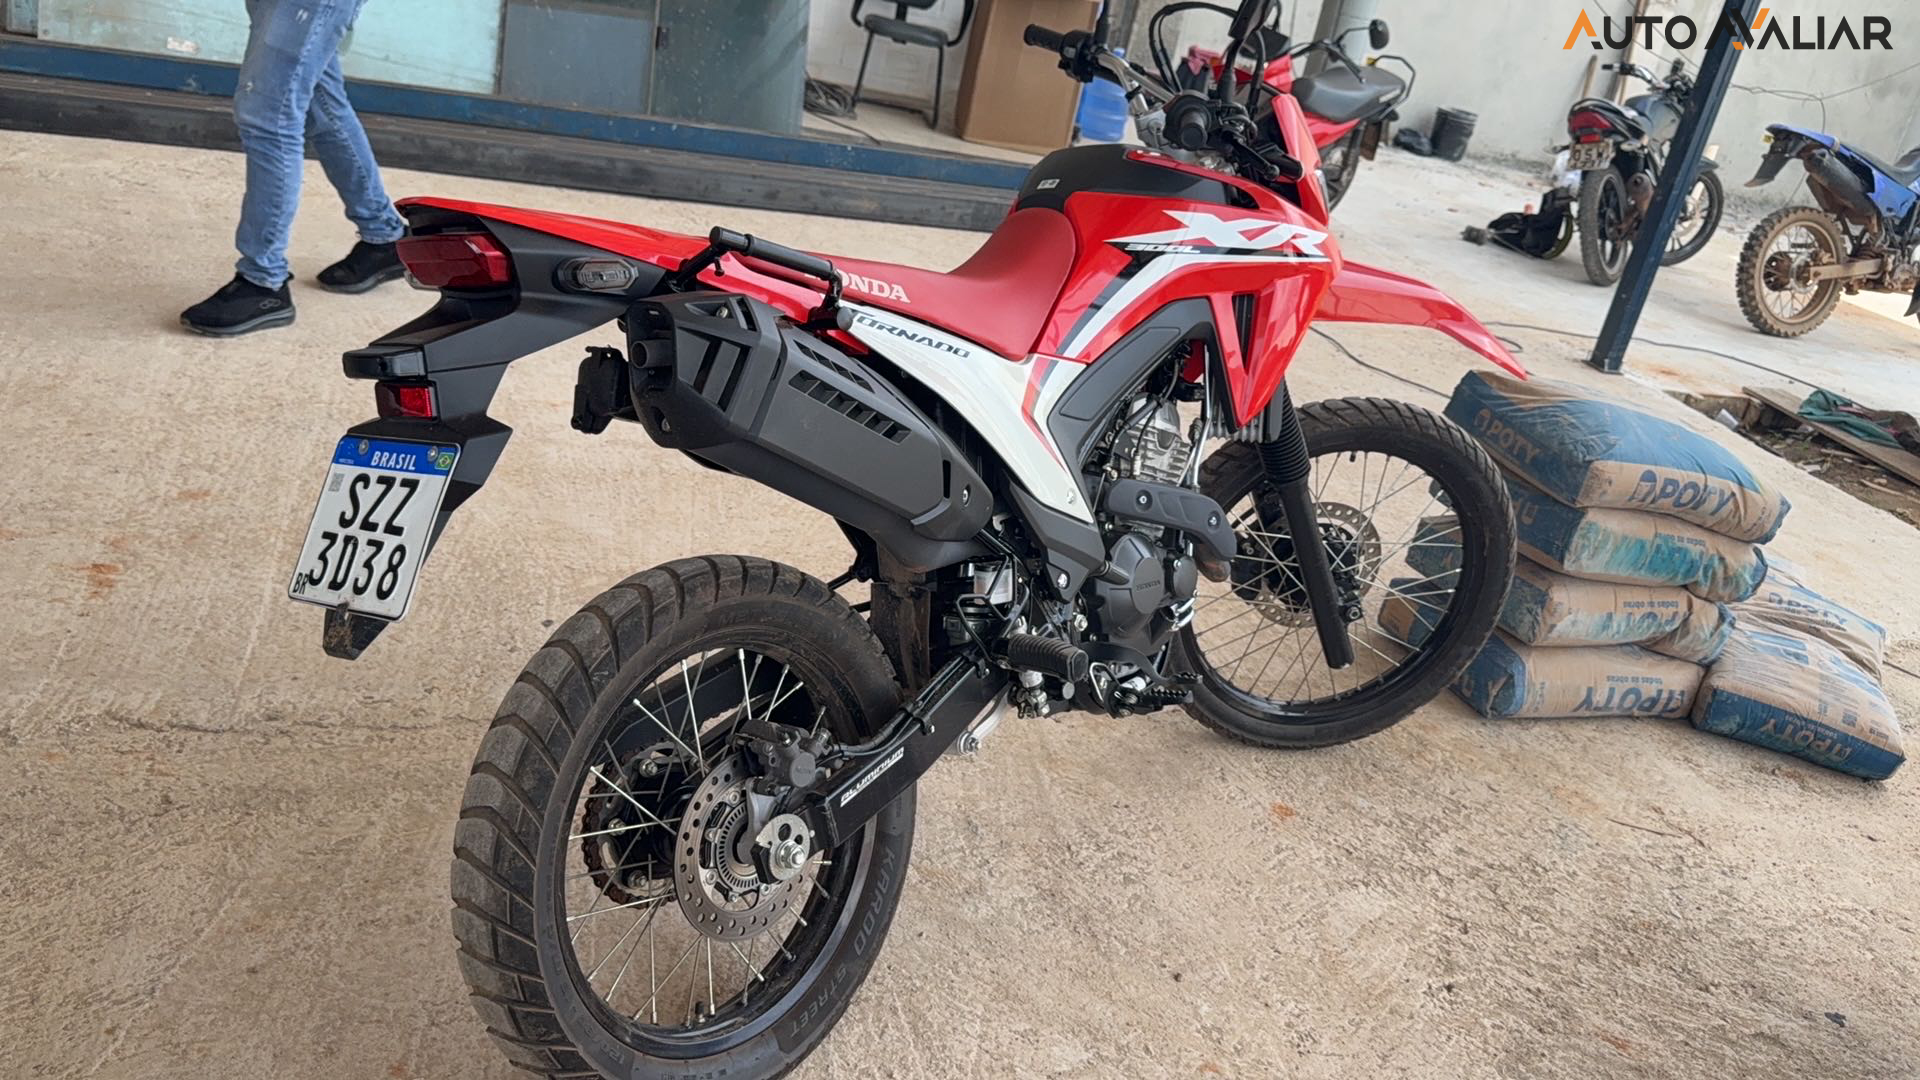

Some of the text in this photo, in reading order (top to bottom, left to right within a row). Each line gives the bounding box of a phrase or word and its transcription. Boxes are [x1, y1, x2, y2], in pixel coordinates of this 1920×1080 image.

[1103, 210, 1328, 257] XR
[370, 451, 417, 471] BRASIL
[338, 473, 420, 537] SZZ
[292, 572, 309, 595] BR
[308, 531, 407, 600] 3D38
[1573, 687, 1663, 713] POTY
[791, 963, 847, 1037] STREET
